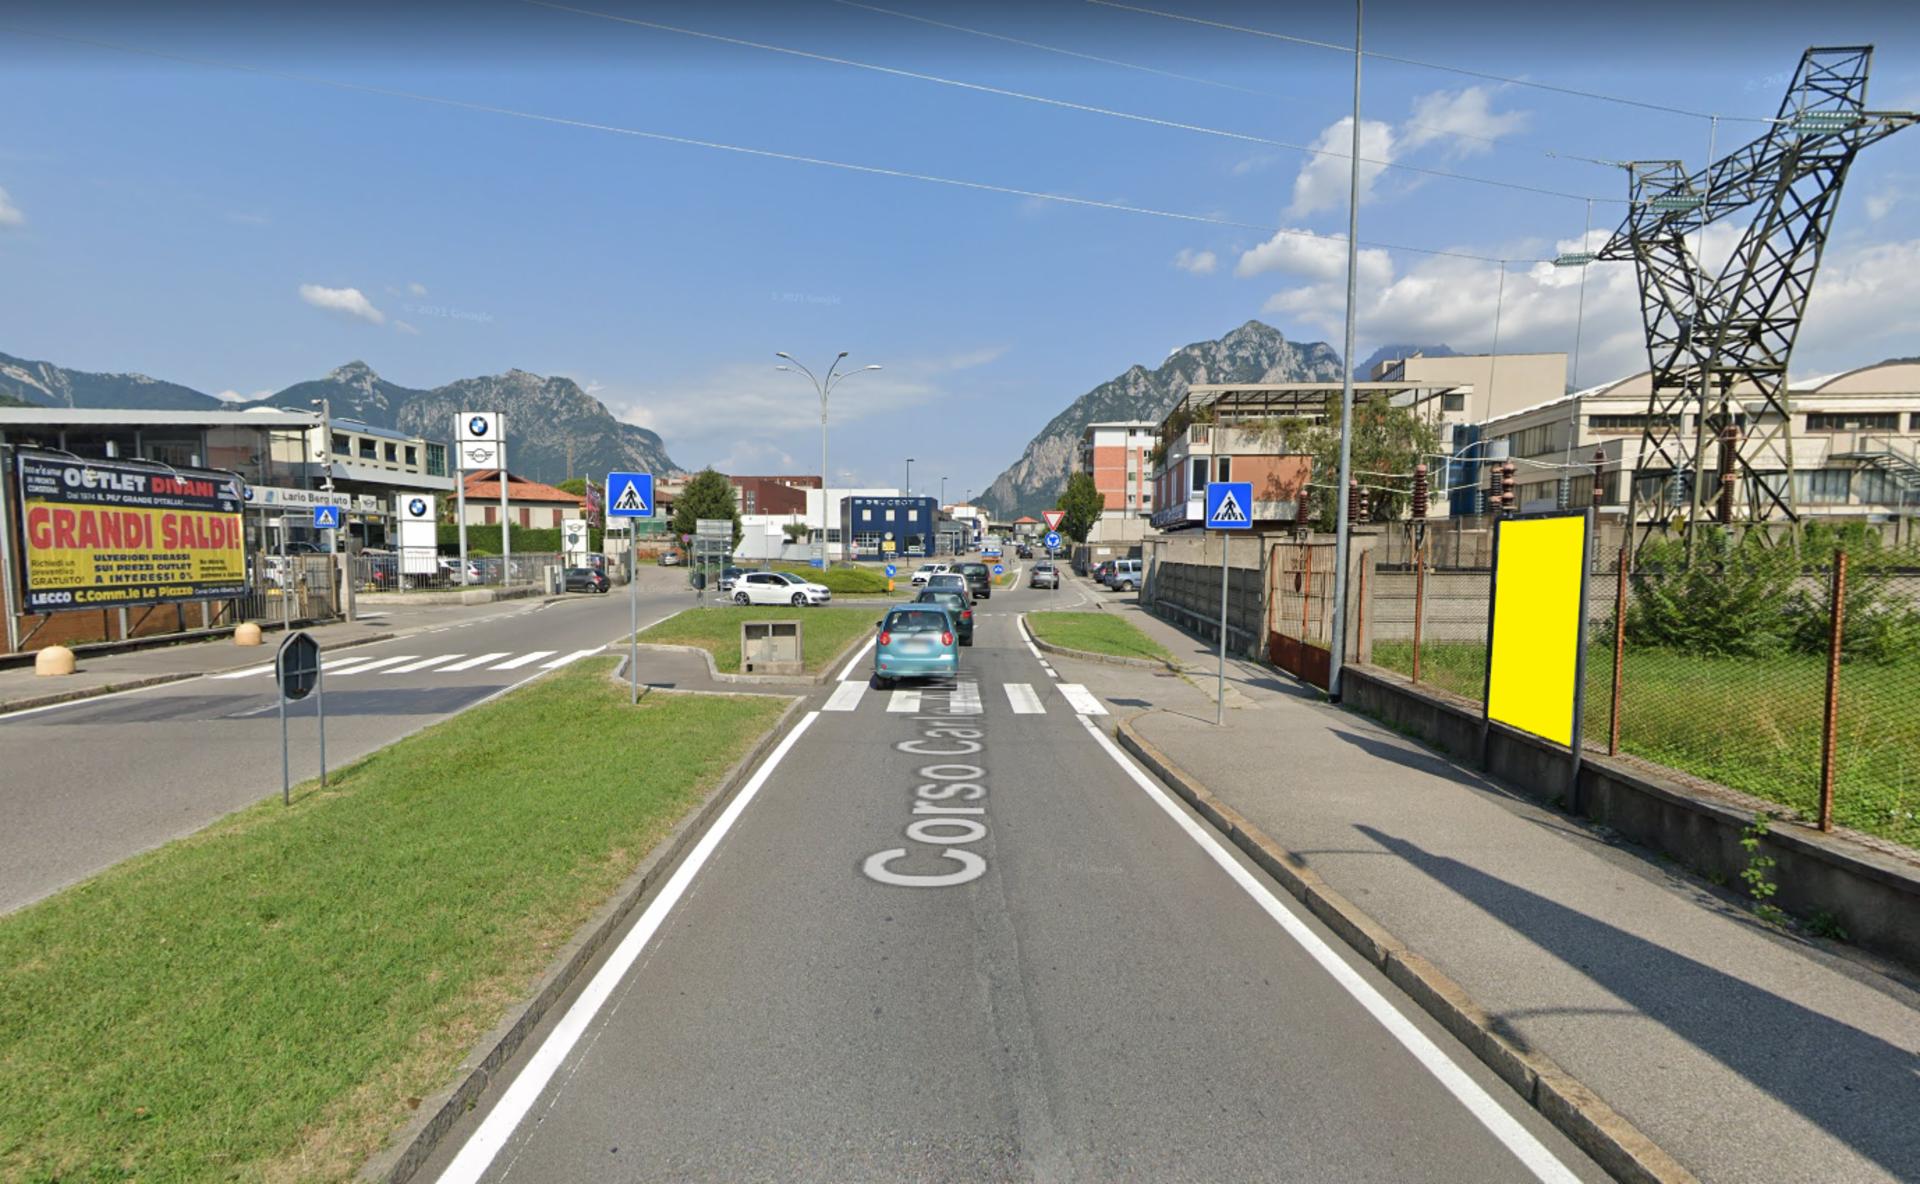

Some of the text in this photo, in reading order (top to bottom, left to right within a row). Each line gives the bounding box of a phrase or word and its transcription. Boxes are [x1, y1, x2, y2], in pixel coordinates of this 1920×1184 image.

[63, 467, 147, 493] OUTLET
[151, 476, 214, 498] DIVANI
[122, 495, 152, 504] GRANDE
[28, 507, 241, 550] GRANDI SALDI!
[152, 553, 191, 561] RIBASSI
[94, 564, 113, 572] SUI
[157, 563, 192, 571] OUTLET
[95, 574, 104, 583] A
[109, 573, 175, 583] INTERESSI
[32, 591, 72, 605] LECCO
[143, 587, 156, 598] Le
[159, 585, 193, 597] Piazze
